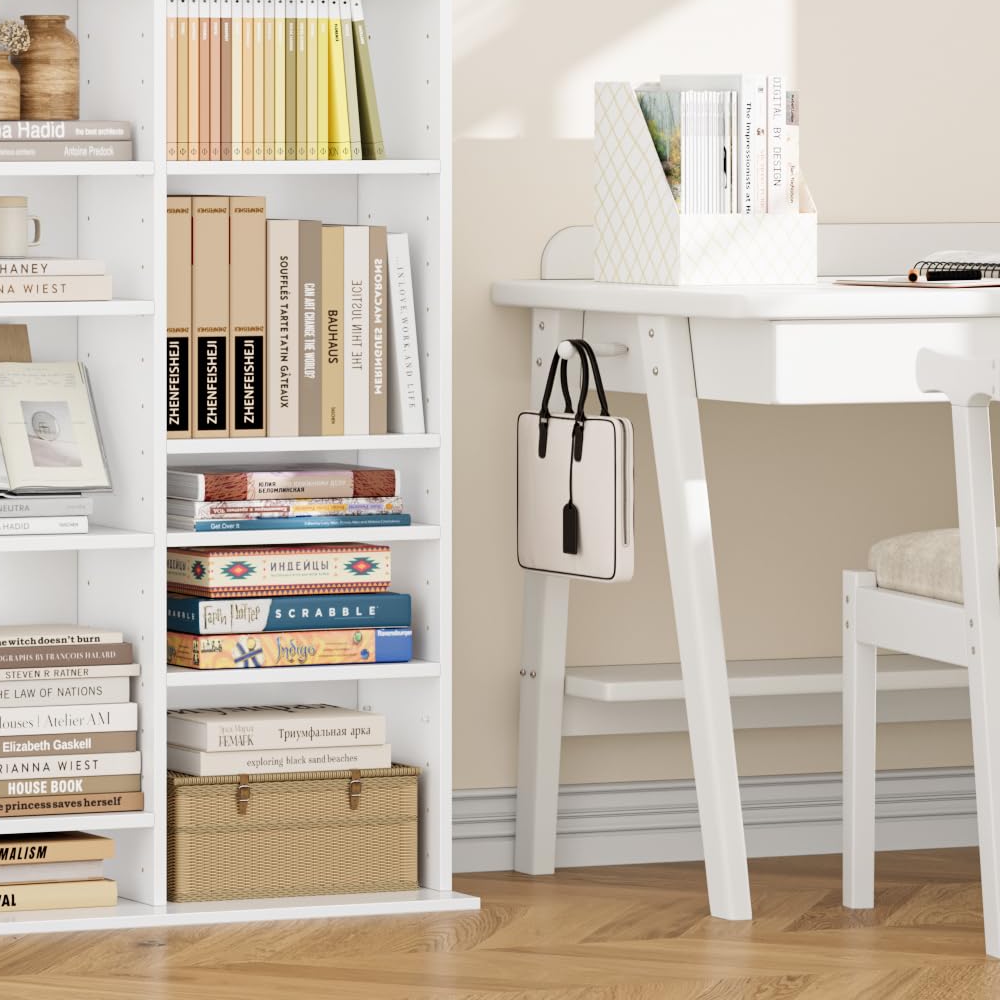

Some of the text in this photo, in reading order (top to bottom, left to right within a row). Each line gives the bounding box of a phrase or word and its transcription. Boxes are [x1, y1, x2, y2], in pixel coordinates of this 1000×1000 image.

[18, 121, 65, 139] Hadid
[772, 76, 782, 186] DIGITAL BY DESIGN
[746, 193, 751, 202] at
[23, 283, 67, 294] WIEST
[304, 283, 315, 296] CAN
[304, 298, 315, 310] ART
[280, 256, 291, 408] SOUFFLÉS TARTE TATIN GÂTEAUX
[303, 312, 315, 337] CHANGE
[328, 310, 338, 364] BAUHAUS
[303, 339, 315, 351] THE
[169, 341, 180, 425] ZHENFEISHEJI
[206, 341, 218, 425] ZHENFEISHEJI
[244, 340, 255, 424] ZHENFEISHEJI
[2, 522, 30, 530] HADID
[270, 559, 330, 572] ИНДЕЙЦЫ
[275, 605, 376, 619] SCRABBLE
[9, 637, 37, 646] witch
[77, 634, 101, 644] burn
[276, 636, 317, 665] Indigo
[14, 689, 36, 698] LAW
[39, 688, 54, 698] OF
[57, 685, 103, 697] NATIONS
[46, 713, 85, 728] Atelier
[88, 712, 111, 726] AM
[278, 726, 371, 742] Триумфальная арка
[2, 738, 92, 753] Elizabeth Gaskell
[58, 759, 100, 771] WIEST
[246, 753, 358, 768] exploring black sand beaches
[8, 779, 83, 794] HOUSE BOOK
[5, 801, 51, 813] princess
[53, 800, 82, 809] saves
[84, 797, 122, 807] herself
